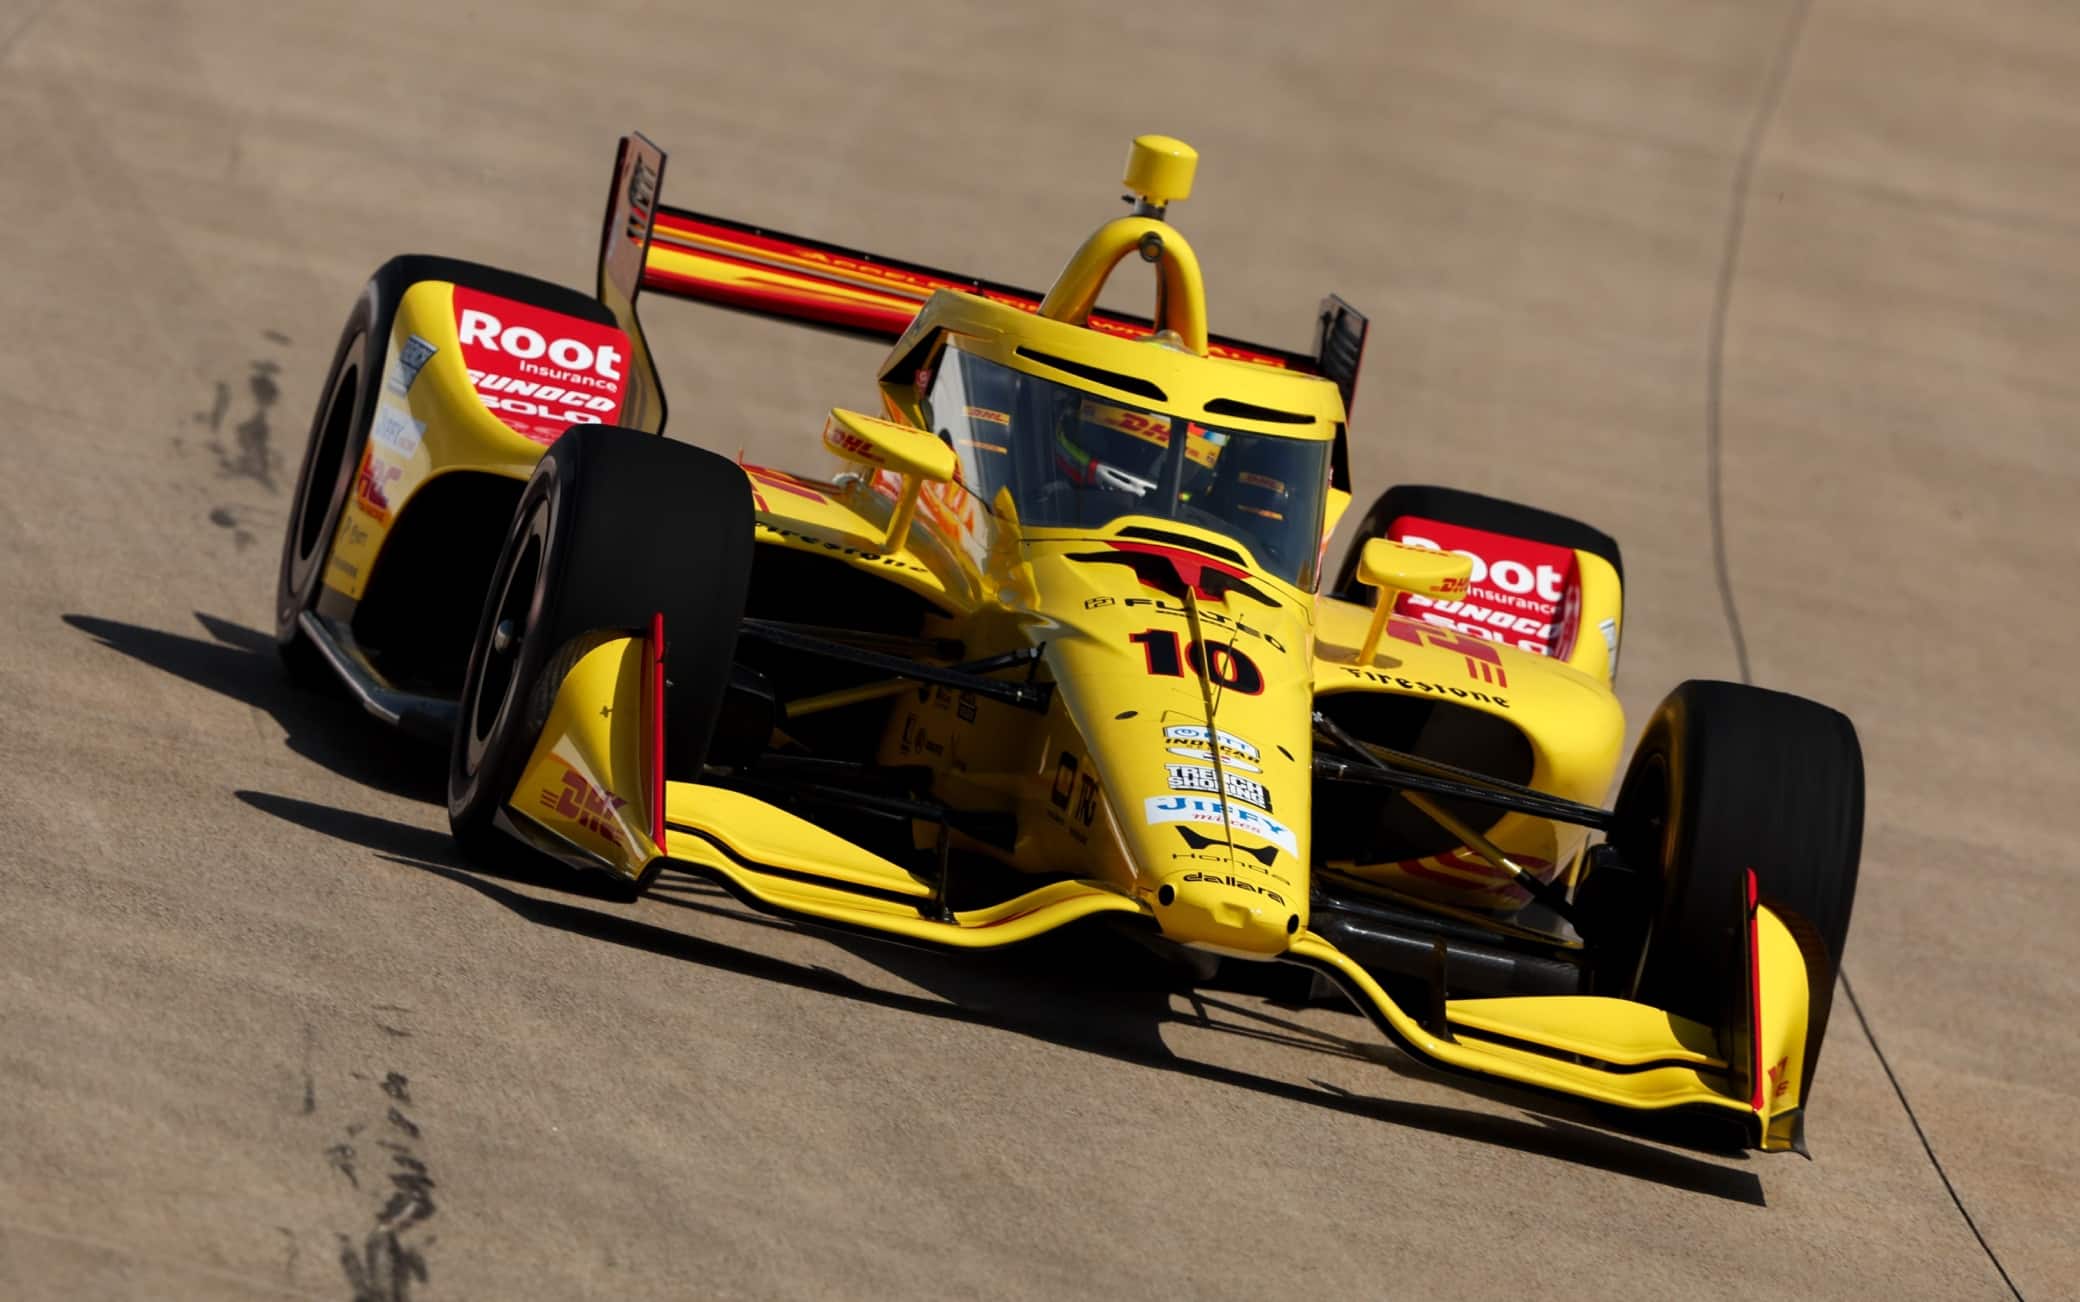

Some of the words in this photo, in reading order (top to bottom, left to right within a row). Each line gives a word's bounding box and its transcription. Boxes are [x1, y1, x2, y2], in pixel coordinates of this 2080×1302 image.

[459, 308, 622, 381] Root
[466, 369, 616, 412] SUNOCO
[1128, 628, 1265, 697] 10
[1339, 666, 1511, 709] Firestone
[1157, 797, 1288, 835] JIFFY
[1183, 871, 1287, 907] dallara
